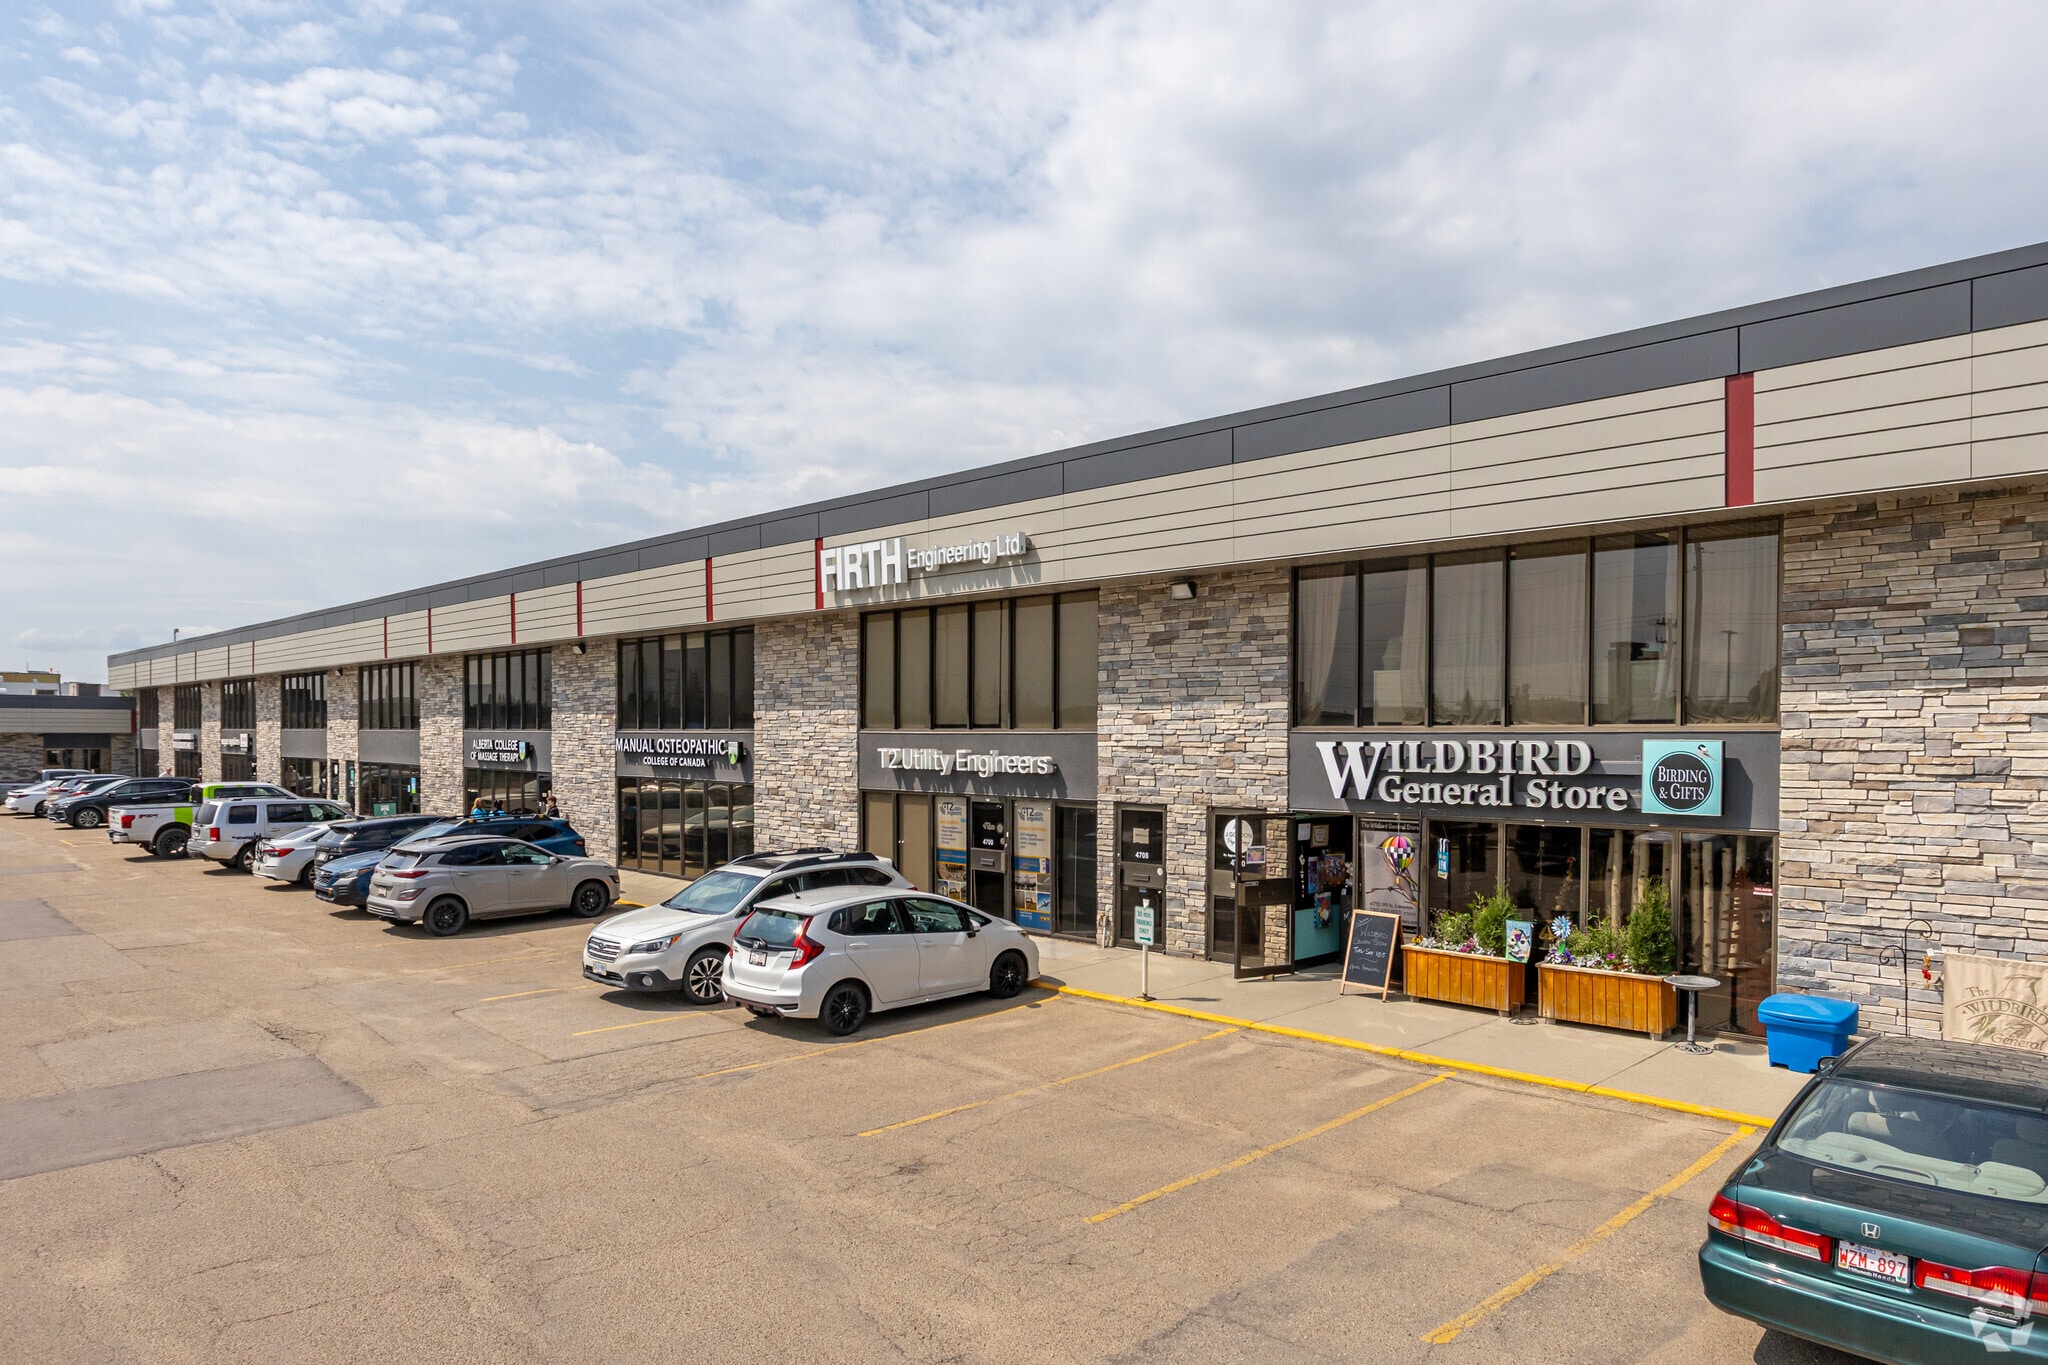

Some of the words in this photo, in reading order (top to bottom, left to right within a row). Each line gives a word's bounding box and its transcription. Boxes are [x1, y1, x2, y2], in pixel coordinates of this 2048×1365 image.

[820, 537, 905, 593] FIRTH
[907, 539, 992, 572] Engineering
[472, 739, 494, 750] ALBERTA
[494, 739, 519, 751] COLLEGE
[615, 738, 655, 753] MANUAL
[656, 738, 726, 756] OSTEOPATHIC
[470, 751, 477, 760] OF
[477, 752, 499, 762] MASSAGE
[499, 752, 519, 763] THERAPY
[643, 756, 669, 767] COLLEGE
[669, 757, 678, 767] OF
[679, 757, 706, 768] CANADA
[877, 748, 900, 769] T2
[901, 748, 953, 776] Utility
[955, 749, 1050, 778] Engineers
[1316, 739, 1594, 800] WILDBIRD
[1657, 765, 1707, 783] BIRDING
[1377, 775, 1514, 807] General
[1525, 778, 1629, 812] Store
[1659, 786, 1668, 800] &
[1670, 783, 1705, 801] GIFTS
[1135, 851, 1149, 859] 4708
[1136, 918, 1152, 927] PARKING
[1965, 986, 1989, 998] The
[1964, 999, 2048, 1026] WILDBIRD
[1991, 1032, 2047, 1051] General
[1839, 1247, 1907, 1278] WZM-897
